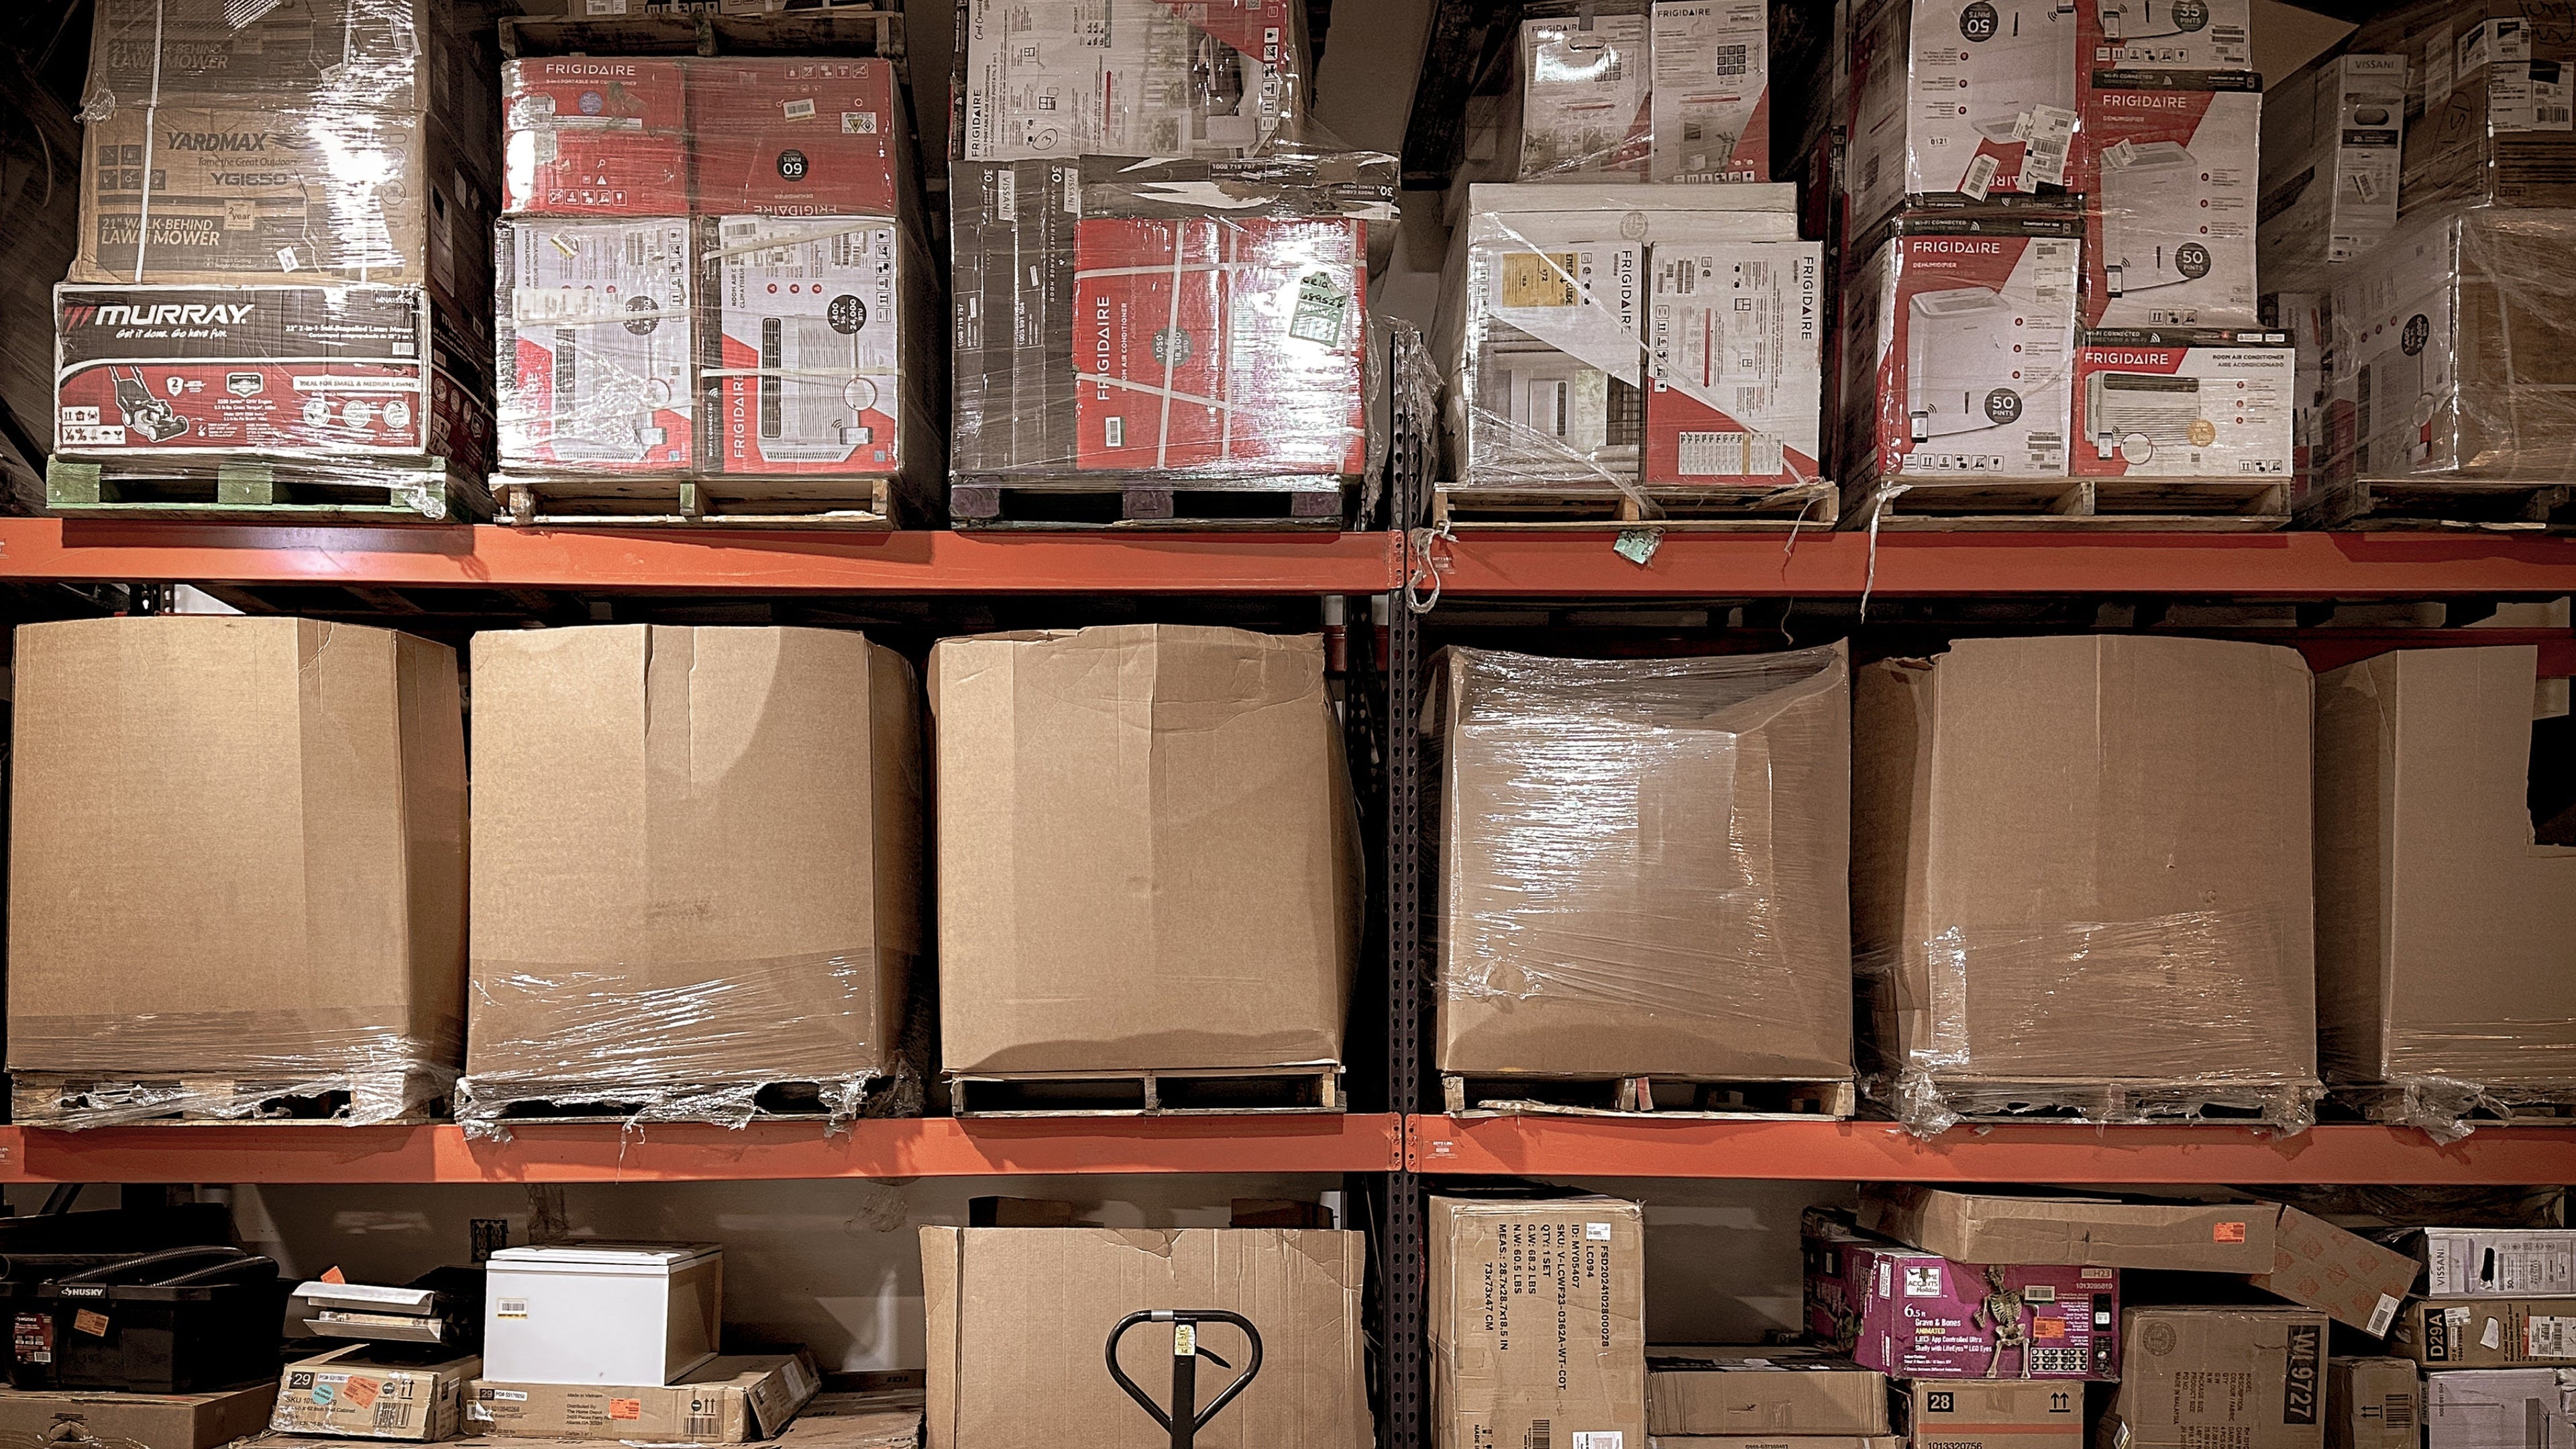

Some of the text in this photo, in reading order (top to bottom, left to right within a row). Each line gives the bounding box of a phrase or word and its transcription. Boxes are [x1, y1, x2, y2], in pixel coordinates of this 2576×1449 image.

[1658, 7, 1711, 17] FRIGIDAIRE
[2180, 3, 2200, 17] 35
[1532, 24, 1578, 34] FRIGIDAIR
[1967, 19, 1990, 34] 50
[545, 64, 636, 76] FRIGIDAIRE
[2354, 60, 2395, 69] VISSANI
[2103, 95, 2187, 109] FRIGIDAIRE
[971, 89, 981, 157] FRIGIDAIRE
[167, 132, 267, 152] YARDMAX
[1041, 136, 1052, 146] 3
[782, 162, 803, 175] 60
[985, 169, 993, 182] 30
[1051, 166, 1062, 182] 30
[1002, 176, 1011, 218] VISSANI
[232, 213, 251, 221] year
[753, 205, 838, 215] FRIGIDAIRE
[101, 218, 122, 230] 21"
[153, 230, 220, 246] MOWER
[1913, 241, 2001, 254] FRIGIDAIRE
[2182, 251, 2204, 264] 50
[1801, 256, 1814, 341] FRIGIDAIRE
[115, 329, 132, 339] Get
[135, 329, 143, 338] it
[171, 329, 186, 338] Go
[1097, 294, 1110, 400] FRIGIDAIRE
[1156, 335, 1164, 359] 1,050
[2084, 352, 2169, 364] FRIGIDAIRE
[172, 378, 179, 388] 2
[1991, 396, 2015, 410] 50
[1542, 1224, 1551, 1248] QTY:
[1513, 1224, 1521, 1295] N.W: 60.5 LBS
[1527, 1224, 1536, 1295] G.W: 68.2 LBS
[1571, 1224, 1580, 1289] ID: MY05407
[1585, 1245, 1594, 1278] LC094
[1542, 1258, 1551, 1278] SET
[2436, 1248, 2445, 1287] VISSANI
[1498, 1224, 1508, 1351] MEAS.: 28.7x28.7x18.5 IN
[2507, 1279, 2514, 1289] 30
[72, 1288, 103, 1297] HUSKY
[1484, 1262, 1493, 1331] 73x73x47 CM
[1600, 1245, 1609, 1347] FSD2024102800028
[1557, 1224, 1567, 1391] SKU: V-LCWF23-0362A-WT-COT
[1904, 1303, 1921, 1318] 6.5
[1915, 1318, 1934, 1327] Grave
[1941, 1319, 1962, 1327] Bones
[1931, 1336, 1942, 1344] App
[2428, 1313, 2445, 1357] D29A
[1915, 1344, 1931, 1352] Skelly
[1980, 1345, 1992, 1353] Eyes
[293, 1373, 311, 1385] 29
[2183, 1371, 2189, 1380] PO
[2237, 1373, 2245, 1411] DESCRIPTION
[2289, 1366, 2314, 1418] 9727
[303, 1397, 337, 1406] 10179
[1930, 1395, 1950, 1409] 28
